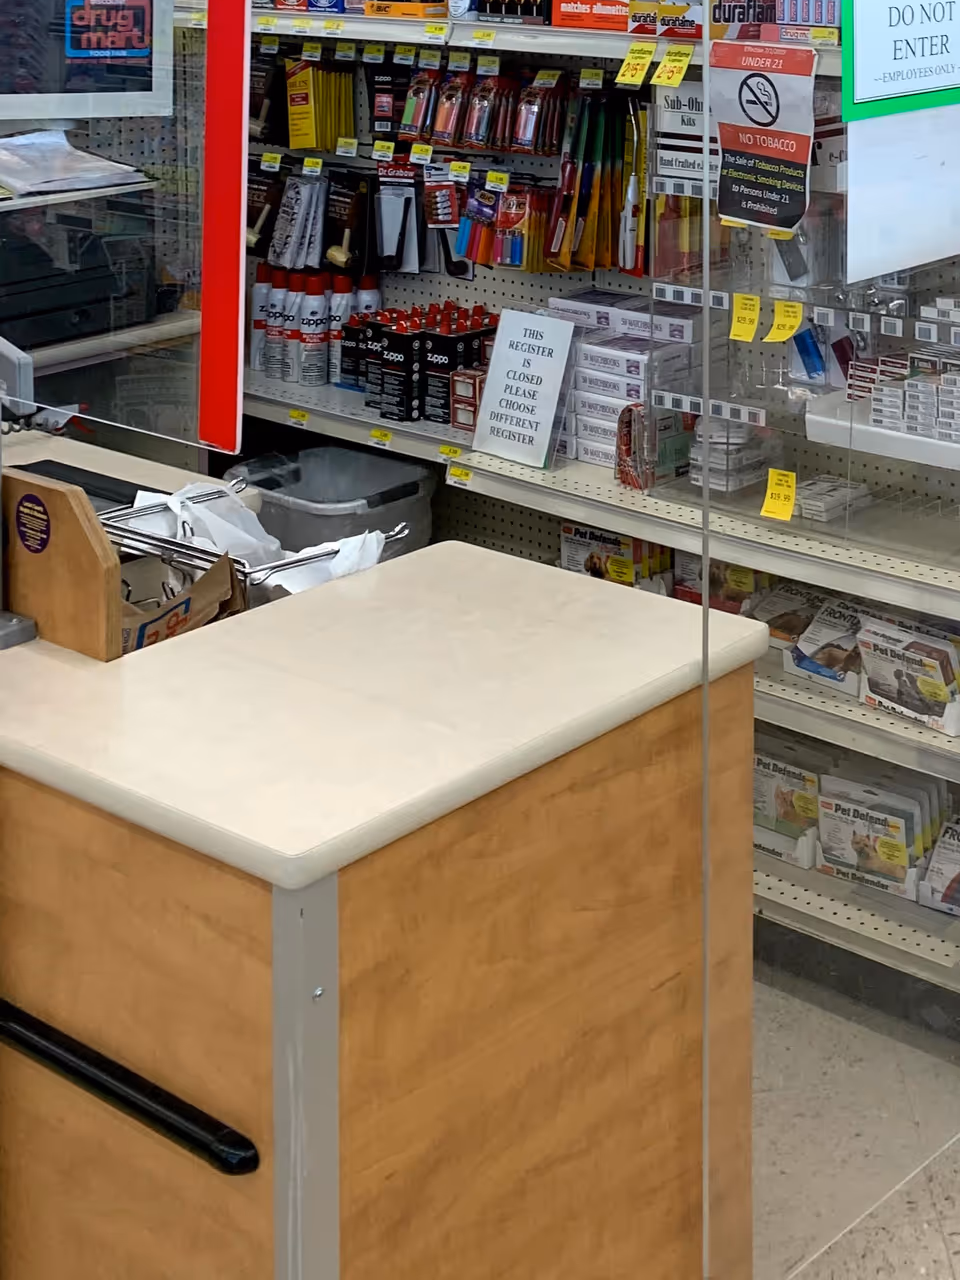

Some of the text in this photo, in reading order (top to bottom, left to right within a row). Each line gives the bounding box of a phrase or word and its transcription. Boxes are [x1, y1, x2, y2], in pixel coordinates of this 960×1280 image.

[376, 5, 391, 13] BIC
[561, 2, 590, 13] matches
[888, 0, 956, 27] DO NOT
[660, 17, 696, 28] duraflame
[81, 28, 149, 49] mart
[892, 34, 951, 61] ENTER
[741, 56, 783, 69] UNDER 21
[934, 63, 956, 76] ONLY
[681, 115, 695, 126] Kits
[739, 133, 796, 152] NO TOBACCO
[660, 156, 673, 166] Hand
[724, 154, 804, 177] The Sale of Tobacco Products
[388, 169, 414, 178] Grabow
[728, 169, 804, 192] Electronic Smoking Devices
[740, 185, 762, 198] Persons
[763, 190, 781, 201] Under
[781, 194, 789, 203] 21
[747, 202, 778, 215] Prohibited
[523, 328, 544, 340] THIS
[508, 341, 554, 358] REGISTER
[522, 359, 531, 368] IS
[506, 370, 543, 386] CLOSED
[504, 384, 539, 400] PLEASE
[499, 398, 537, 416] CHOOSE
[489, 411, 540, 432] DIFFERENT
[489, 426, 535, 446] REGISTER
[574, 527, 588, 539] Pet
[873, 644, 889, 657] Pet
[757, 758, 770, 771] Pet
[835, 804, 850, 817] Pet
[836, 868, 888, 890] Pet Defender
